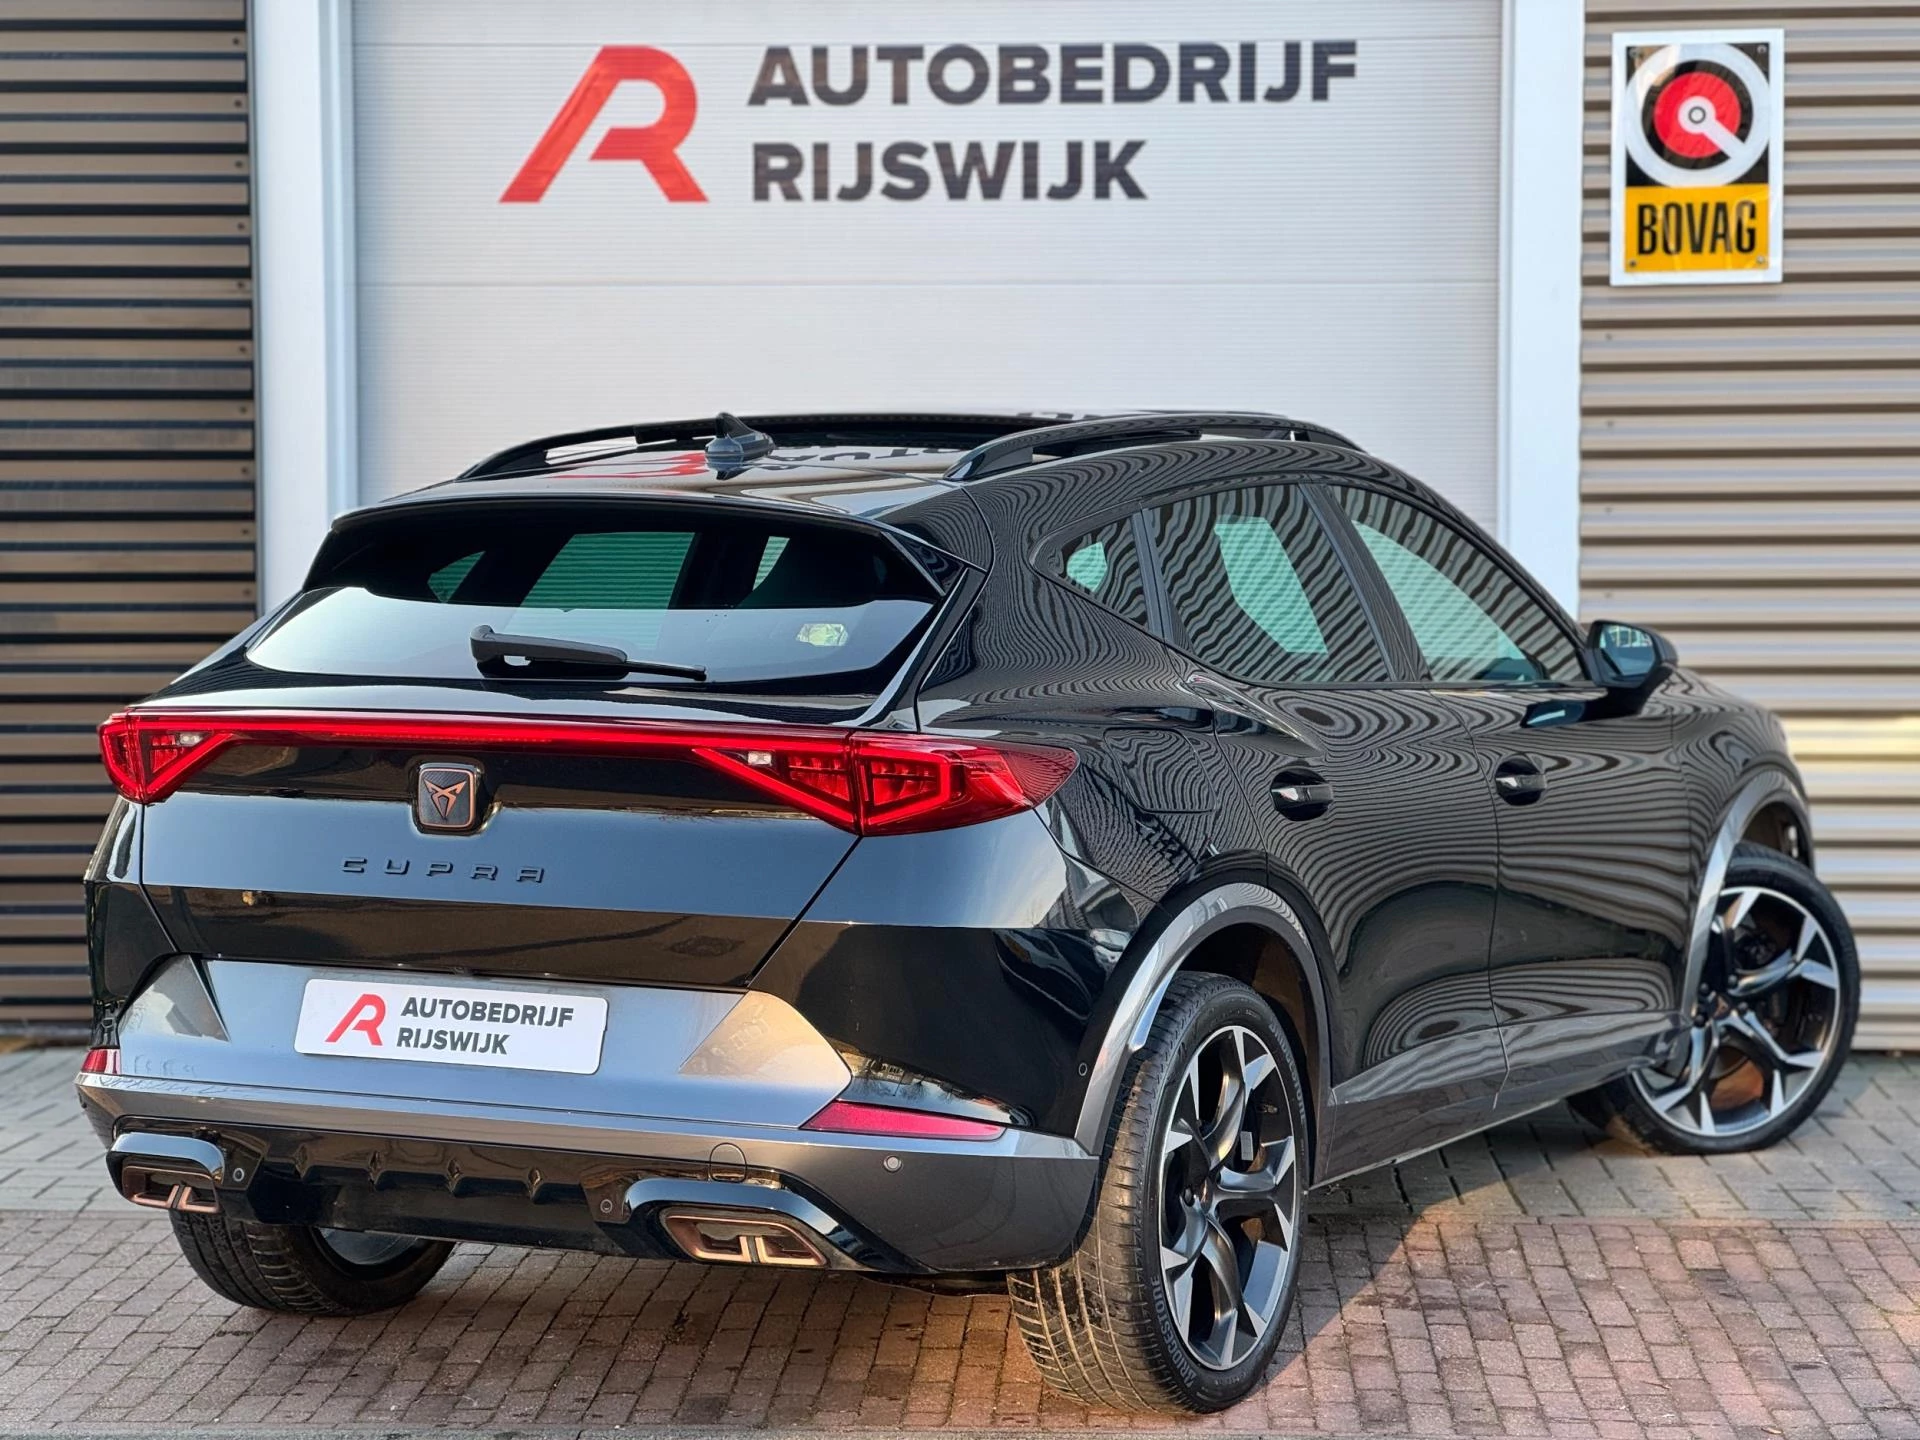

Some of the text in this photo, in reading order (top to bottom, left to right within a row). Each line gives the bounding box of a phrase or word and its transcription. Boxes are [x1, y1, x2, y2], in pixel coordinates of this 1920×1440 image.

[747, 40, 1358, 106] AUTOBEDRIJF
[753, 140, 1148, 203] RIJSWIJK
[1637, 200, 1757, 256] BOVAG
[342, 856, 547, 884] CUPRA
[400, 996, 574, 1029] AUTOBEDRIJF
[396, 1027, 511, 1055] RIJSWIJK
[1151, 1275, 1198, 1388] BRIDGESTONE
